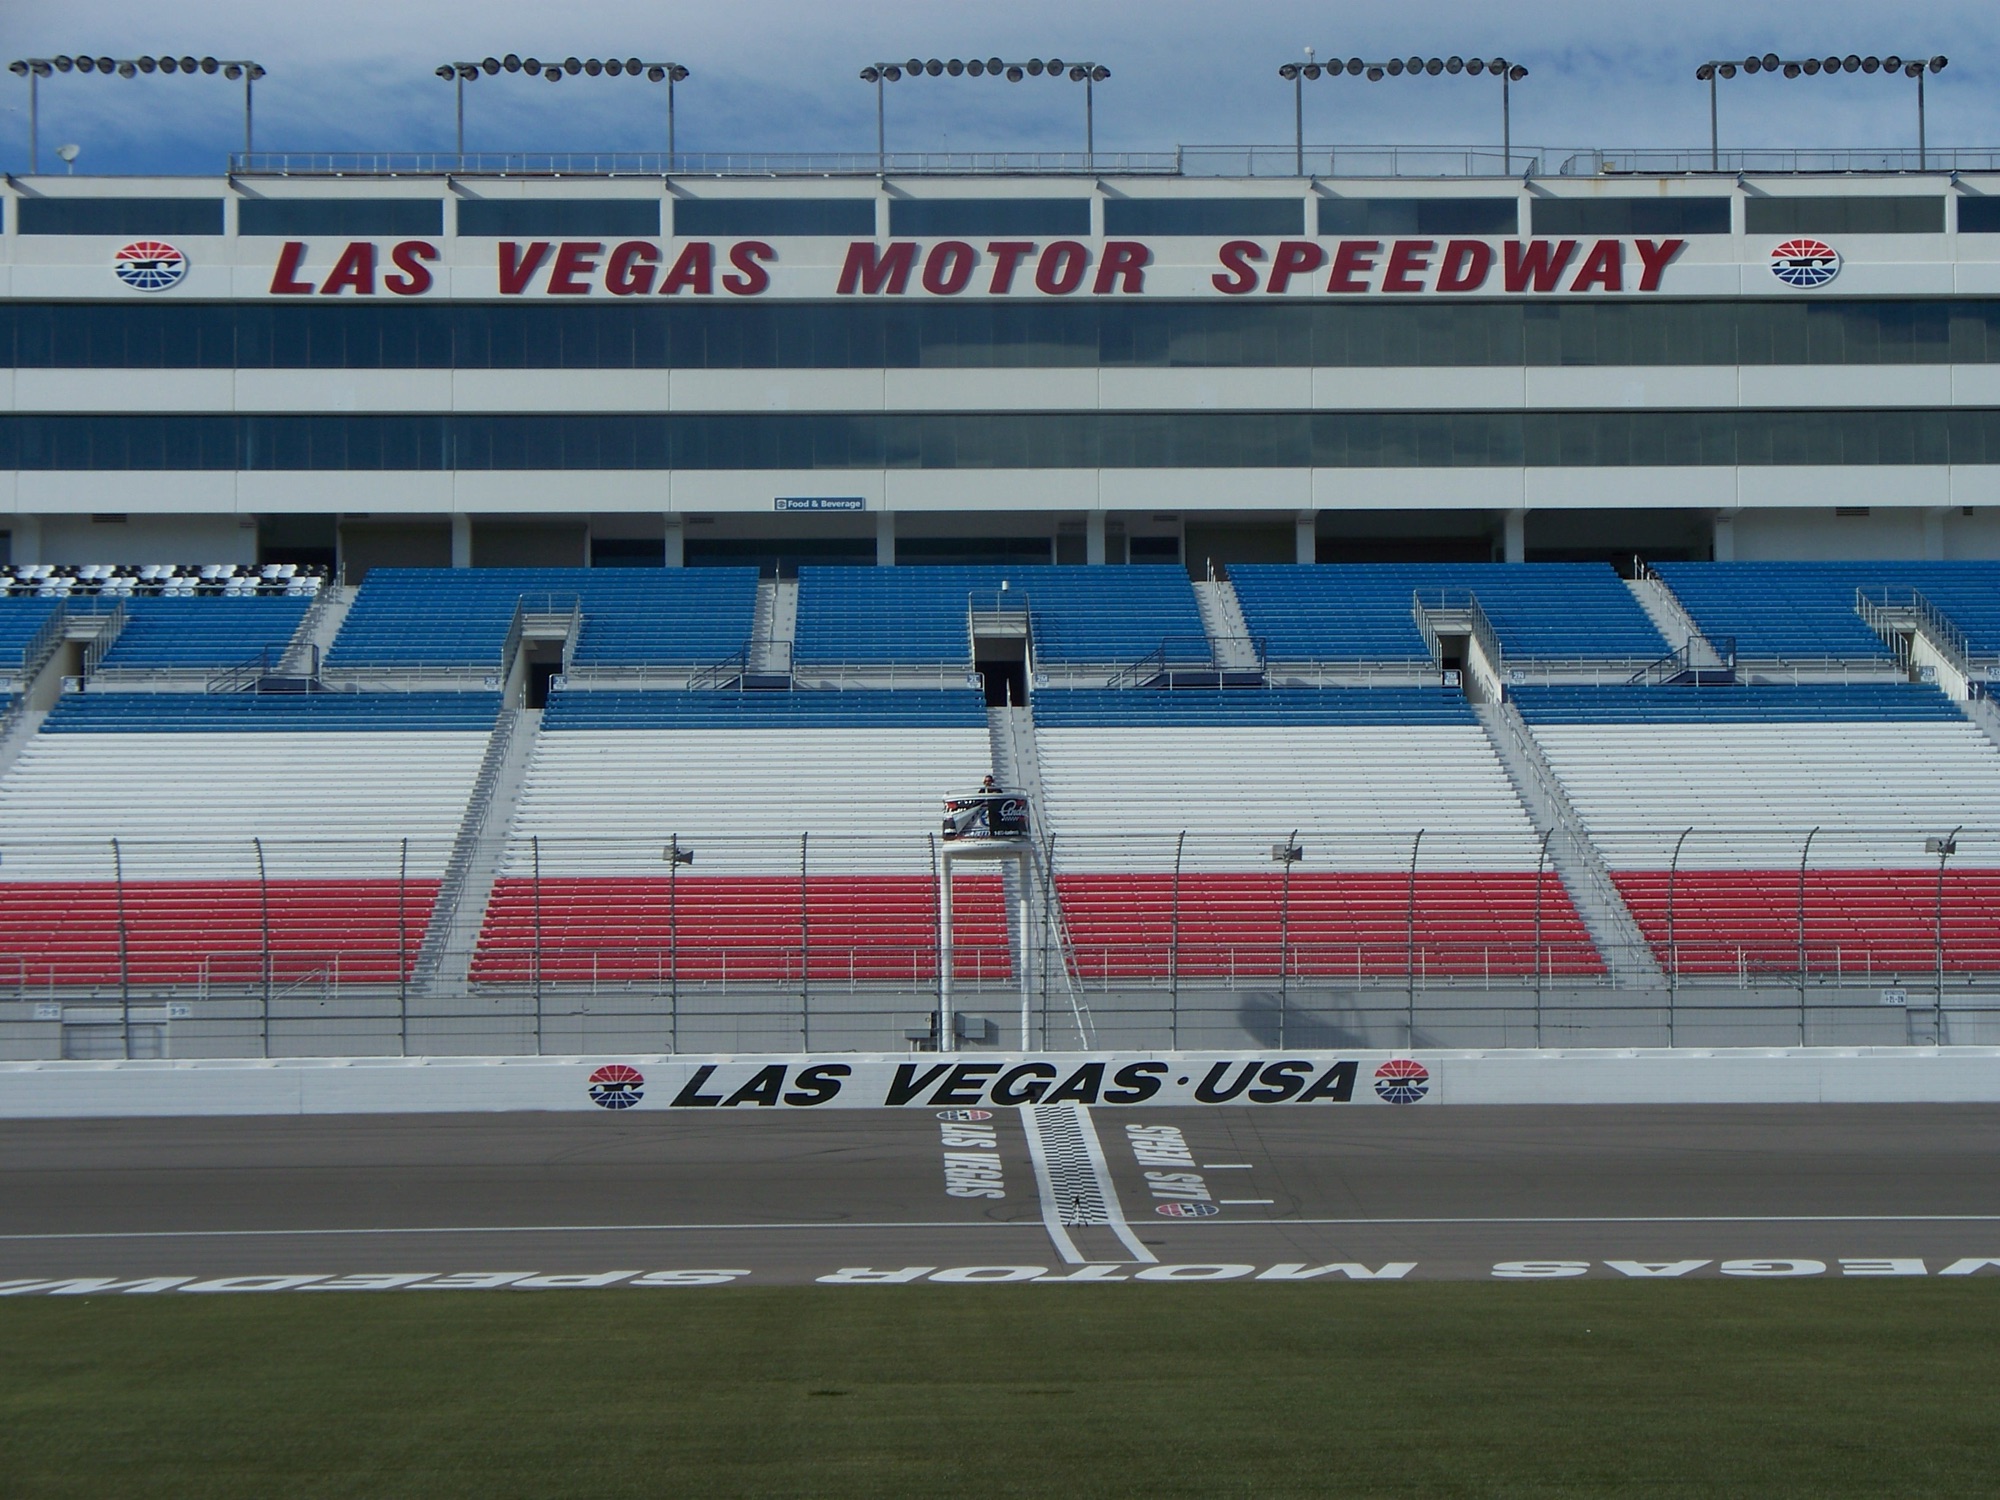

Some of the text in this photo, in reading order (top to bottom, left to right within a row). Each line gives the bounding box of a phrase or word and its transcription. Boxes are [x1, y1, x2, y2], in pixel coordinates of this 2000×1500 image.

[271, 239, 1684, 295] LAS VEGAS MOTOR SPEEDWAY
[787, 499, 861, 509] Food & Beverage
[669, 1061, 1359, 1108] LAS VEGAS USA
[940, 1122, 1006, 1199] LAS VEGAS
[1125, 1124, 1212, 1201] LAS VEGAS
[0, 1269, 752, 1295] SPEEDW
[814, 1263, 1419, 1284] MOTOR
